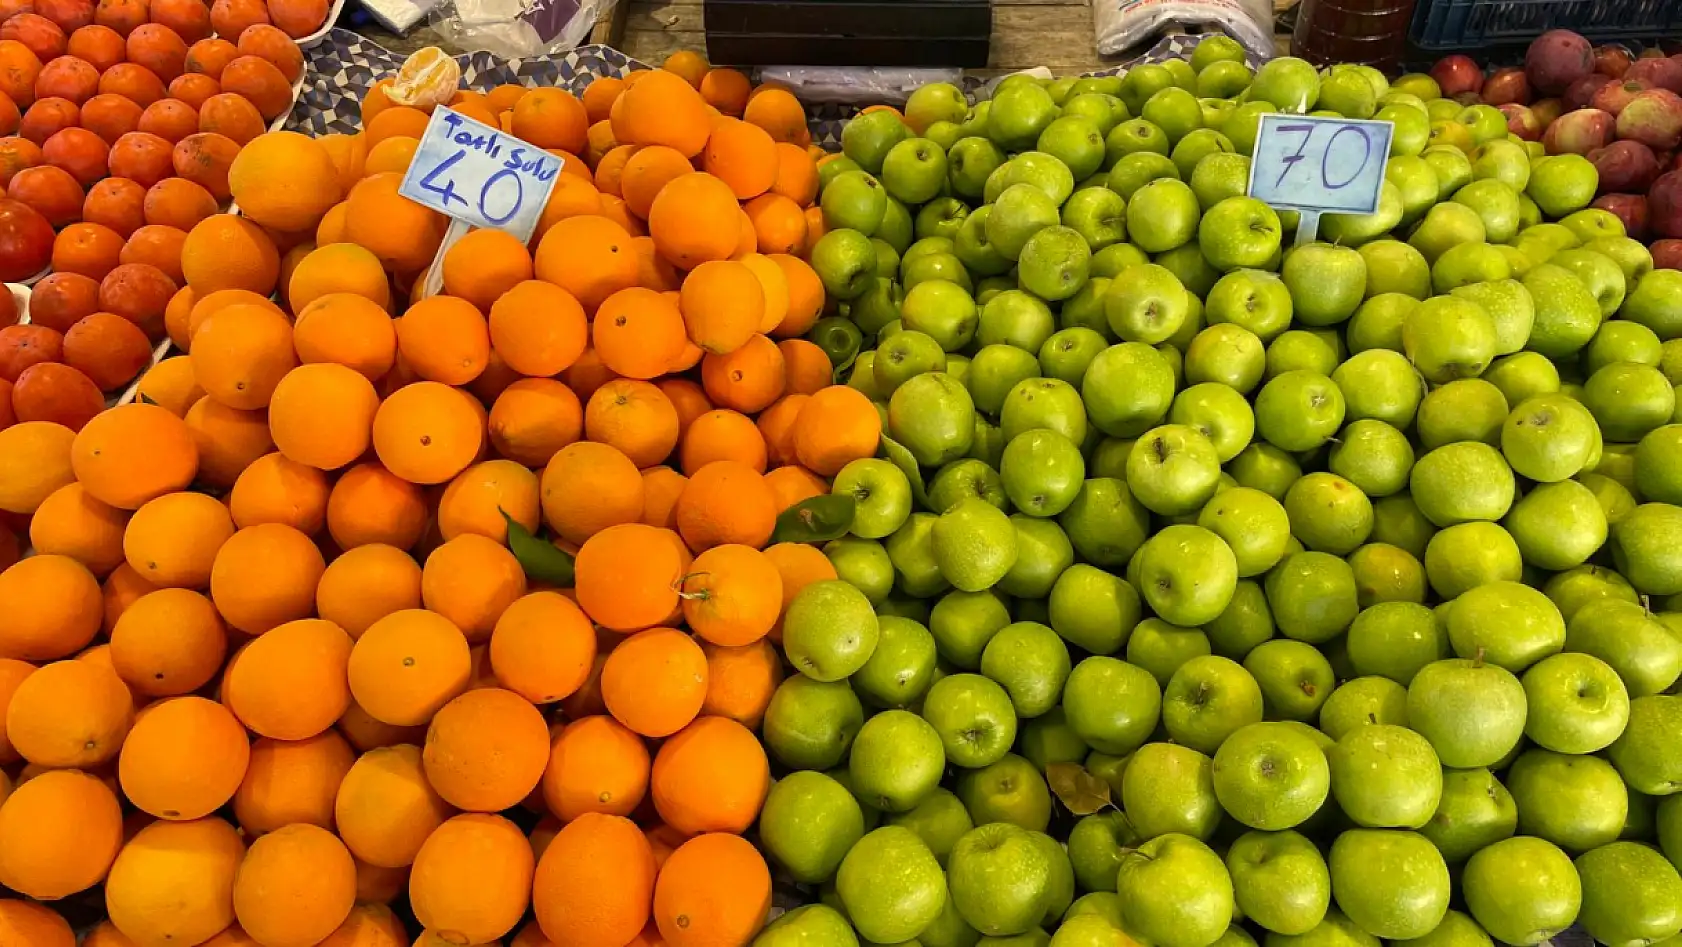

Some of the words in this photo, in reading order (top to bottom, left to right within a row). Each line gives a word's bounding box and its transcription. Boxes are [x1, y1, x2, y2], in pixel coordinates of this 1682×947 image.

[419, 149, 523, 225] 40
[503, 148, 557, 181] Sulu
[1275, 125, 1371, 190] 70
